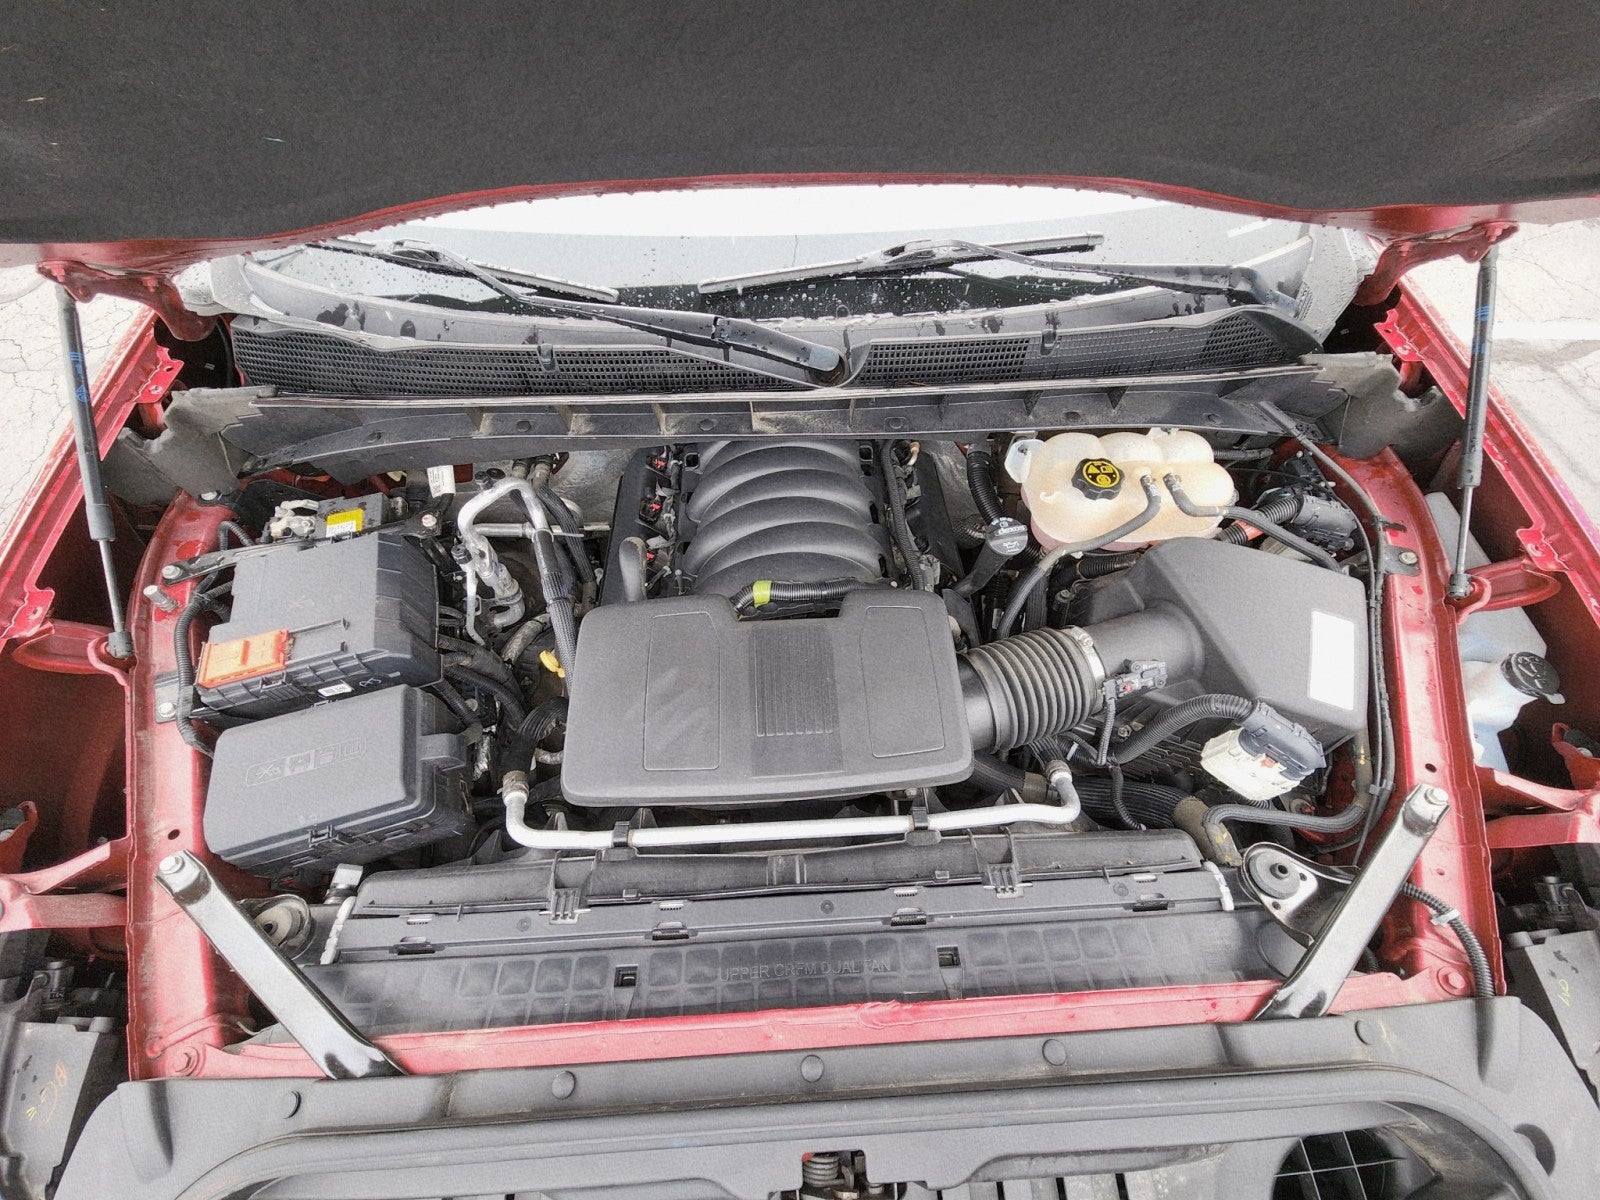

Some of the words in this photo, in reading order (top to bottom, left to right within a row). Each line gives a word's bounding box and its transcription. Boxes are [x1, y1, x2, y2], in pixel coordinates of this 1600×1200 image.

[719, 964, 770, 982] UPPER
[821, 960, 860, 974] DUAL
[864, 959, 891, 972] FAN
